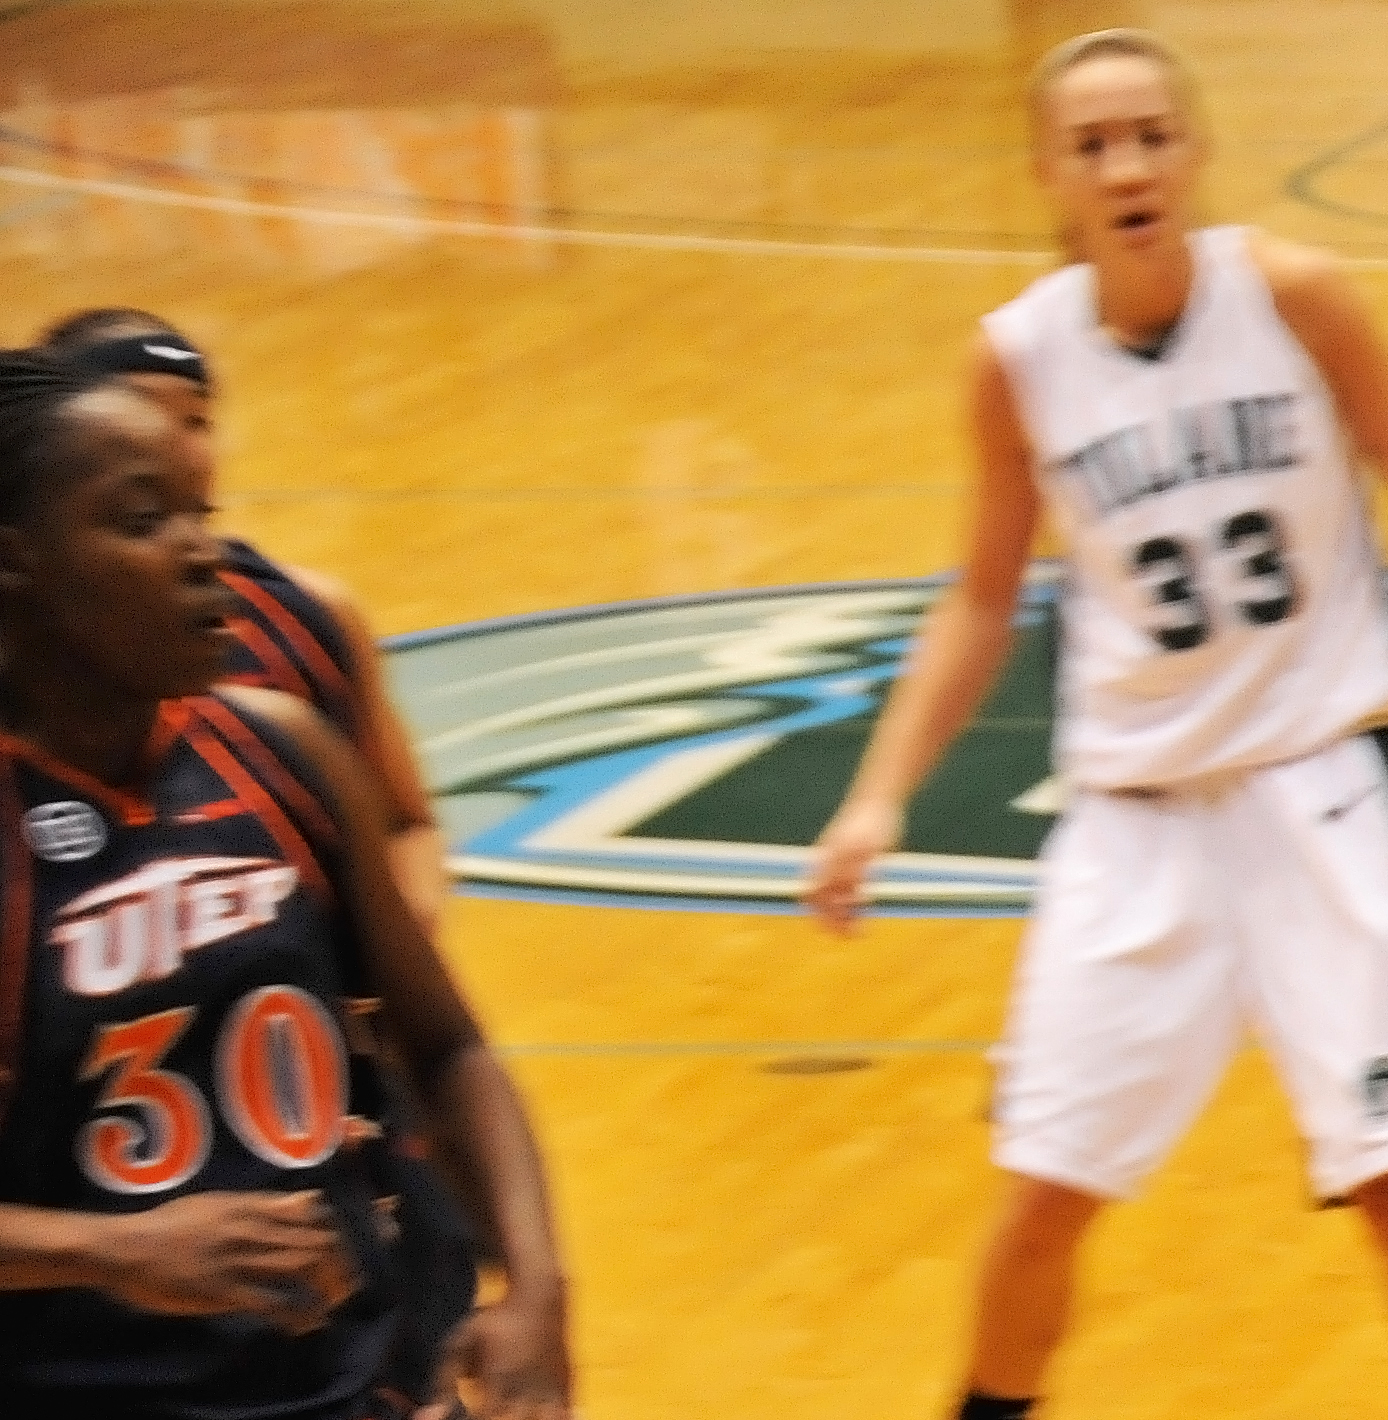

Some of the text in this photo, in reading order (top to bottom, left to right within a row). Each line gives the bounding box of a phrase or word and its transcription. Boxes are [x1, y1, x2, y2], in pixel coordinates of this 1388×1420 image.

[1128, 508, 1298, 650] 33
[46, 855, 300, 997] UTEP
[74, 983, 351, 1194] 30
